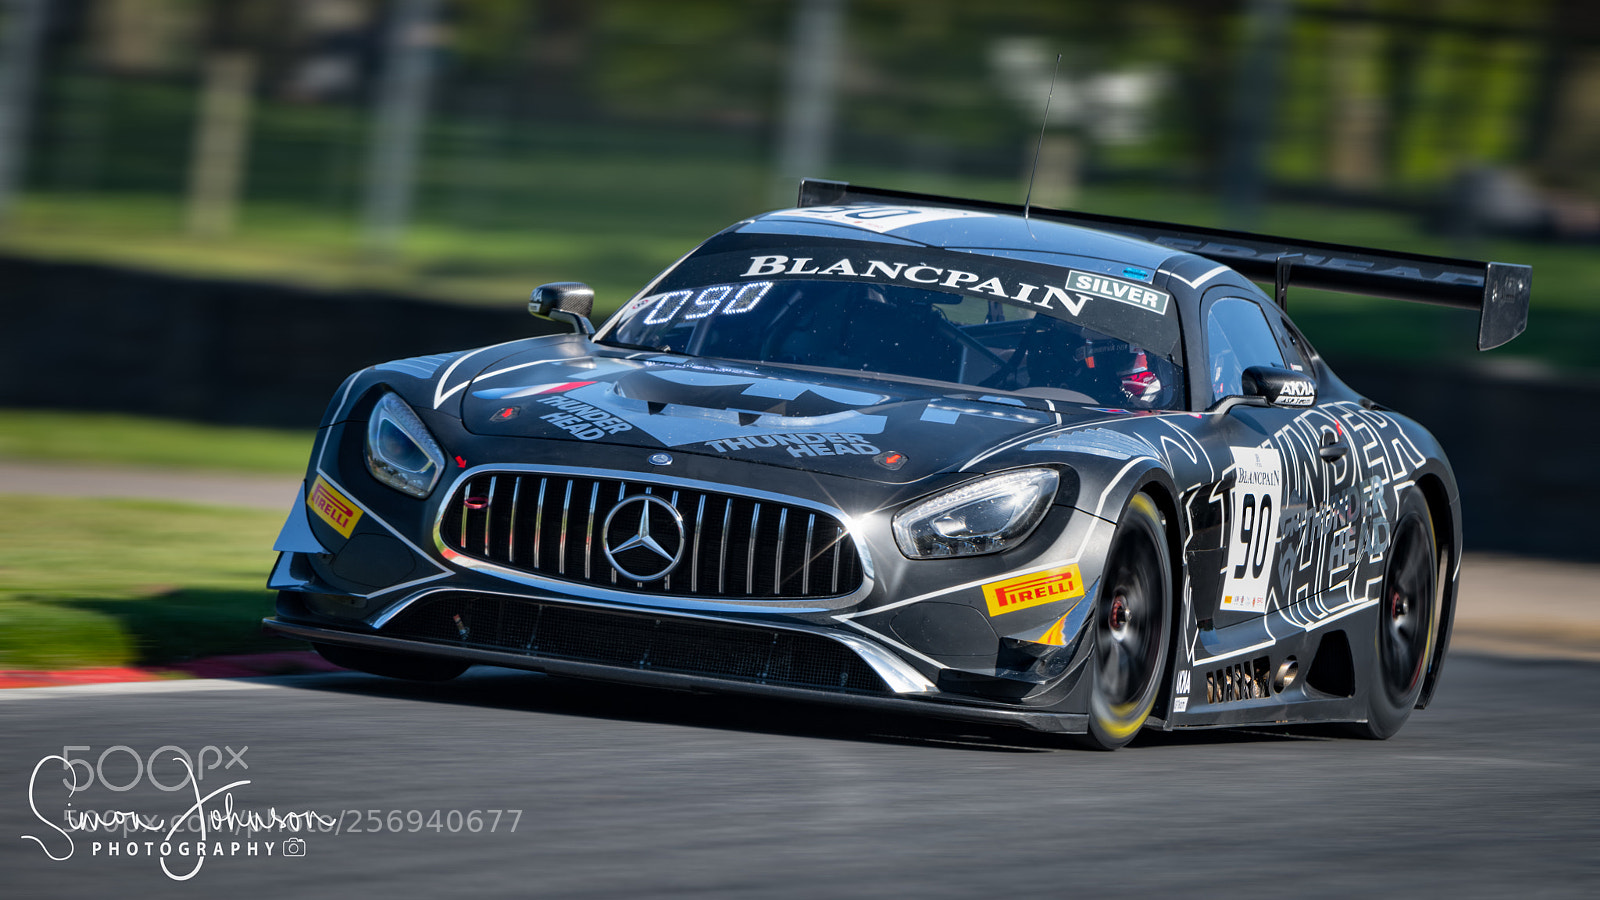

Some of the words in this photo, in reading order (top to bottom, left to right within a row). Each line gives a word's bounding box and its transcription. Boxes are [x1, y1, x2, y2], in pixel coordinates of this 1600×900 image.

[643, 281, 774, 325] 090
[739, 255, 1094, 317] BLANCPAIN
[1075, 275, 1160, 309] SILVER
[536, 395, 632, 435] THUNDER
[539, 410, 606, 441] HEAD
[704, 432, 871, 454] THUNDER
[788, 442, 881, 458] HEAD
[1238, 467, 1280, 487] BLANCPAIN
[311, 483, 355, 529] PIRELLI
[1233, 493, 1273, 580] 90
[995, 571, 1075, 608] PIRELLI
